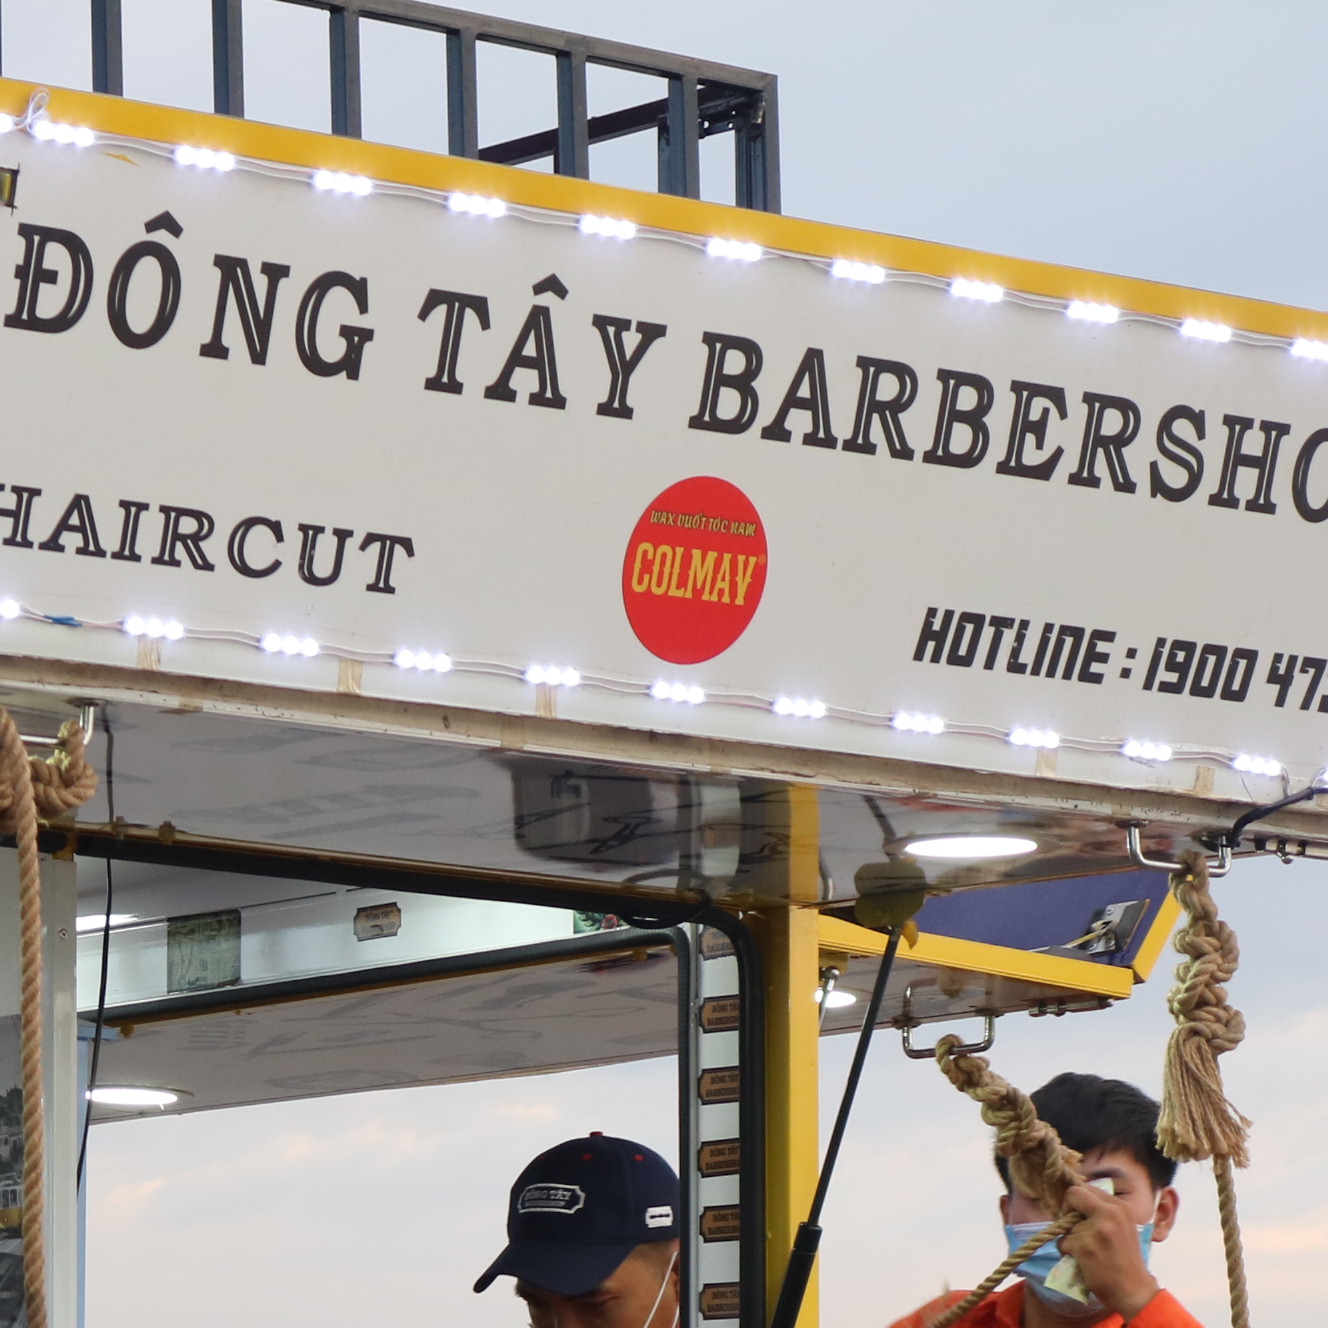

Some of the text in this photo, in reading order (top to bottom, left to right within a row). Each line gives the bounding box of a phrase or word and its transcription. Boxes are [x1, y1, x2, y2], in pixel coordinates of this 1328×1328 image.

[3, 210, 375, 381] ĐÔNG
[416, 272, 668, 420] TÂY
[650, 509, 676, 526] WAX
[631, 541, 758, 606] COLMAY
